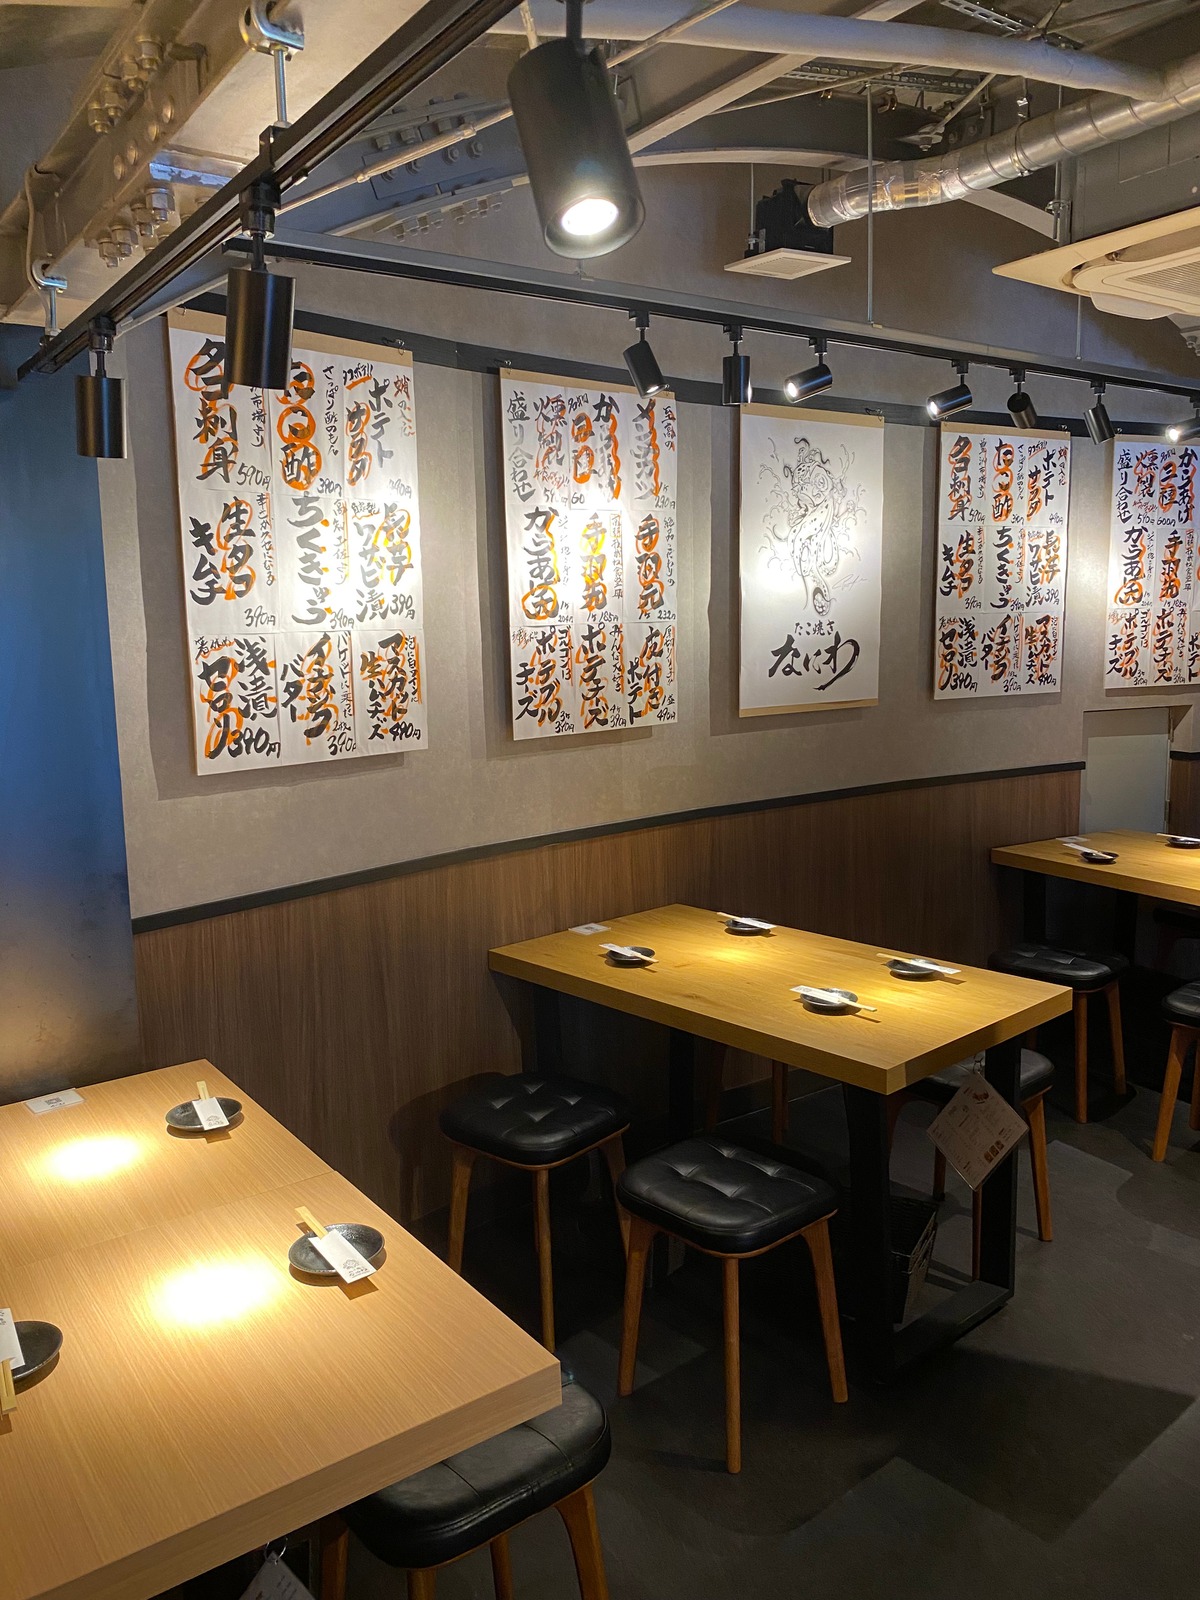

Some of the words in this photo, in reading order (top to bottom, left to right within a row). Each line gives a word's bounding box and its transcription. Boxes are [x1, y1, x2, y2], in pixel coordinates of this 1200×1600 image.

[346, 401, 369, 485] サラダ
[368, 378, 394, 468] ポテト
[507, 391, 536, 502] 盛り合わせ
[236, 463, 271, 490] 590円
[948, 435, 971, 521] タコ刺身
[1027, 465, 1041, 518] サラダ
[1042, 449, 1057, 506] ポテト
[1116, 449, 1133, 523] 盛り合わせ
[1178, 447, 1198, 524] からあげ
[189, 516, 227, 606] キムチ
[222, 496, 256, 598] 生タコ
[287, 492, 332, 625] ちくきゅう
[939, 543, 958, 597] キムチ
[958, 529, 976, 592] 生タコ
[244, 605, 276, 628] 390円
[330, 608, 355, 629] 390円
[794, 619, 835, 636] たこ焼き
[957, 616, 977, 668] 浅漬
[1036, 615, 1051, 672] マスカット
[234, 636, 278, 721] 浅漬
[378, 633, 409, 721] マスカット
[581, 622, 609, 729] ポテチーズ
[768, 631, 860, 691] なにわ
[939, 628, 957, 690] セロリ
[981, 627, 995, 670] バター
[1106, 635, 1123, 675] チーズ
[198, 656, 236, 760] セロリ
[280, 653, 304, 722] バター
[515, 662, 540, 721] チーズ
[627, 657, 644, 725] ポテト
[950, 672, 978, 692] 390円
[227, 726, 281, 759] 390円
